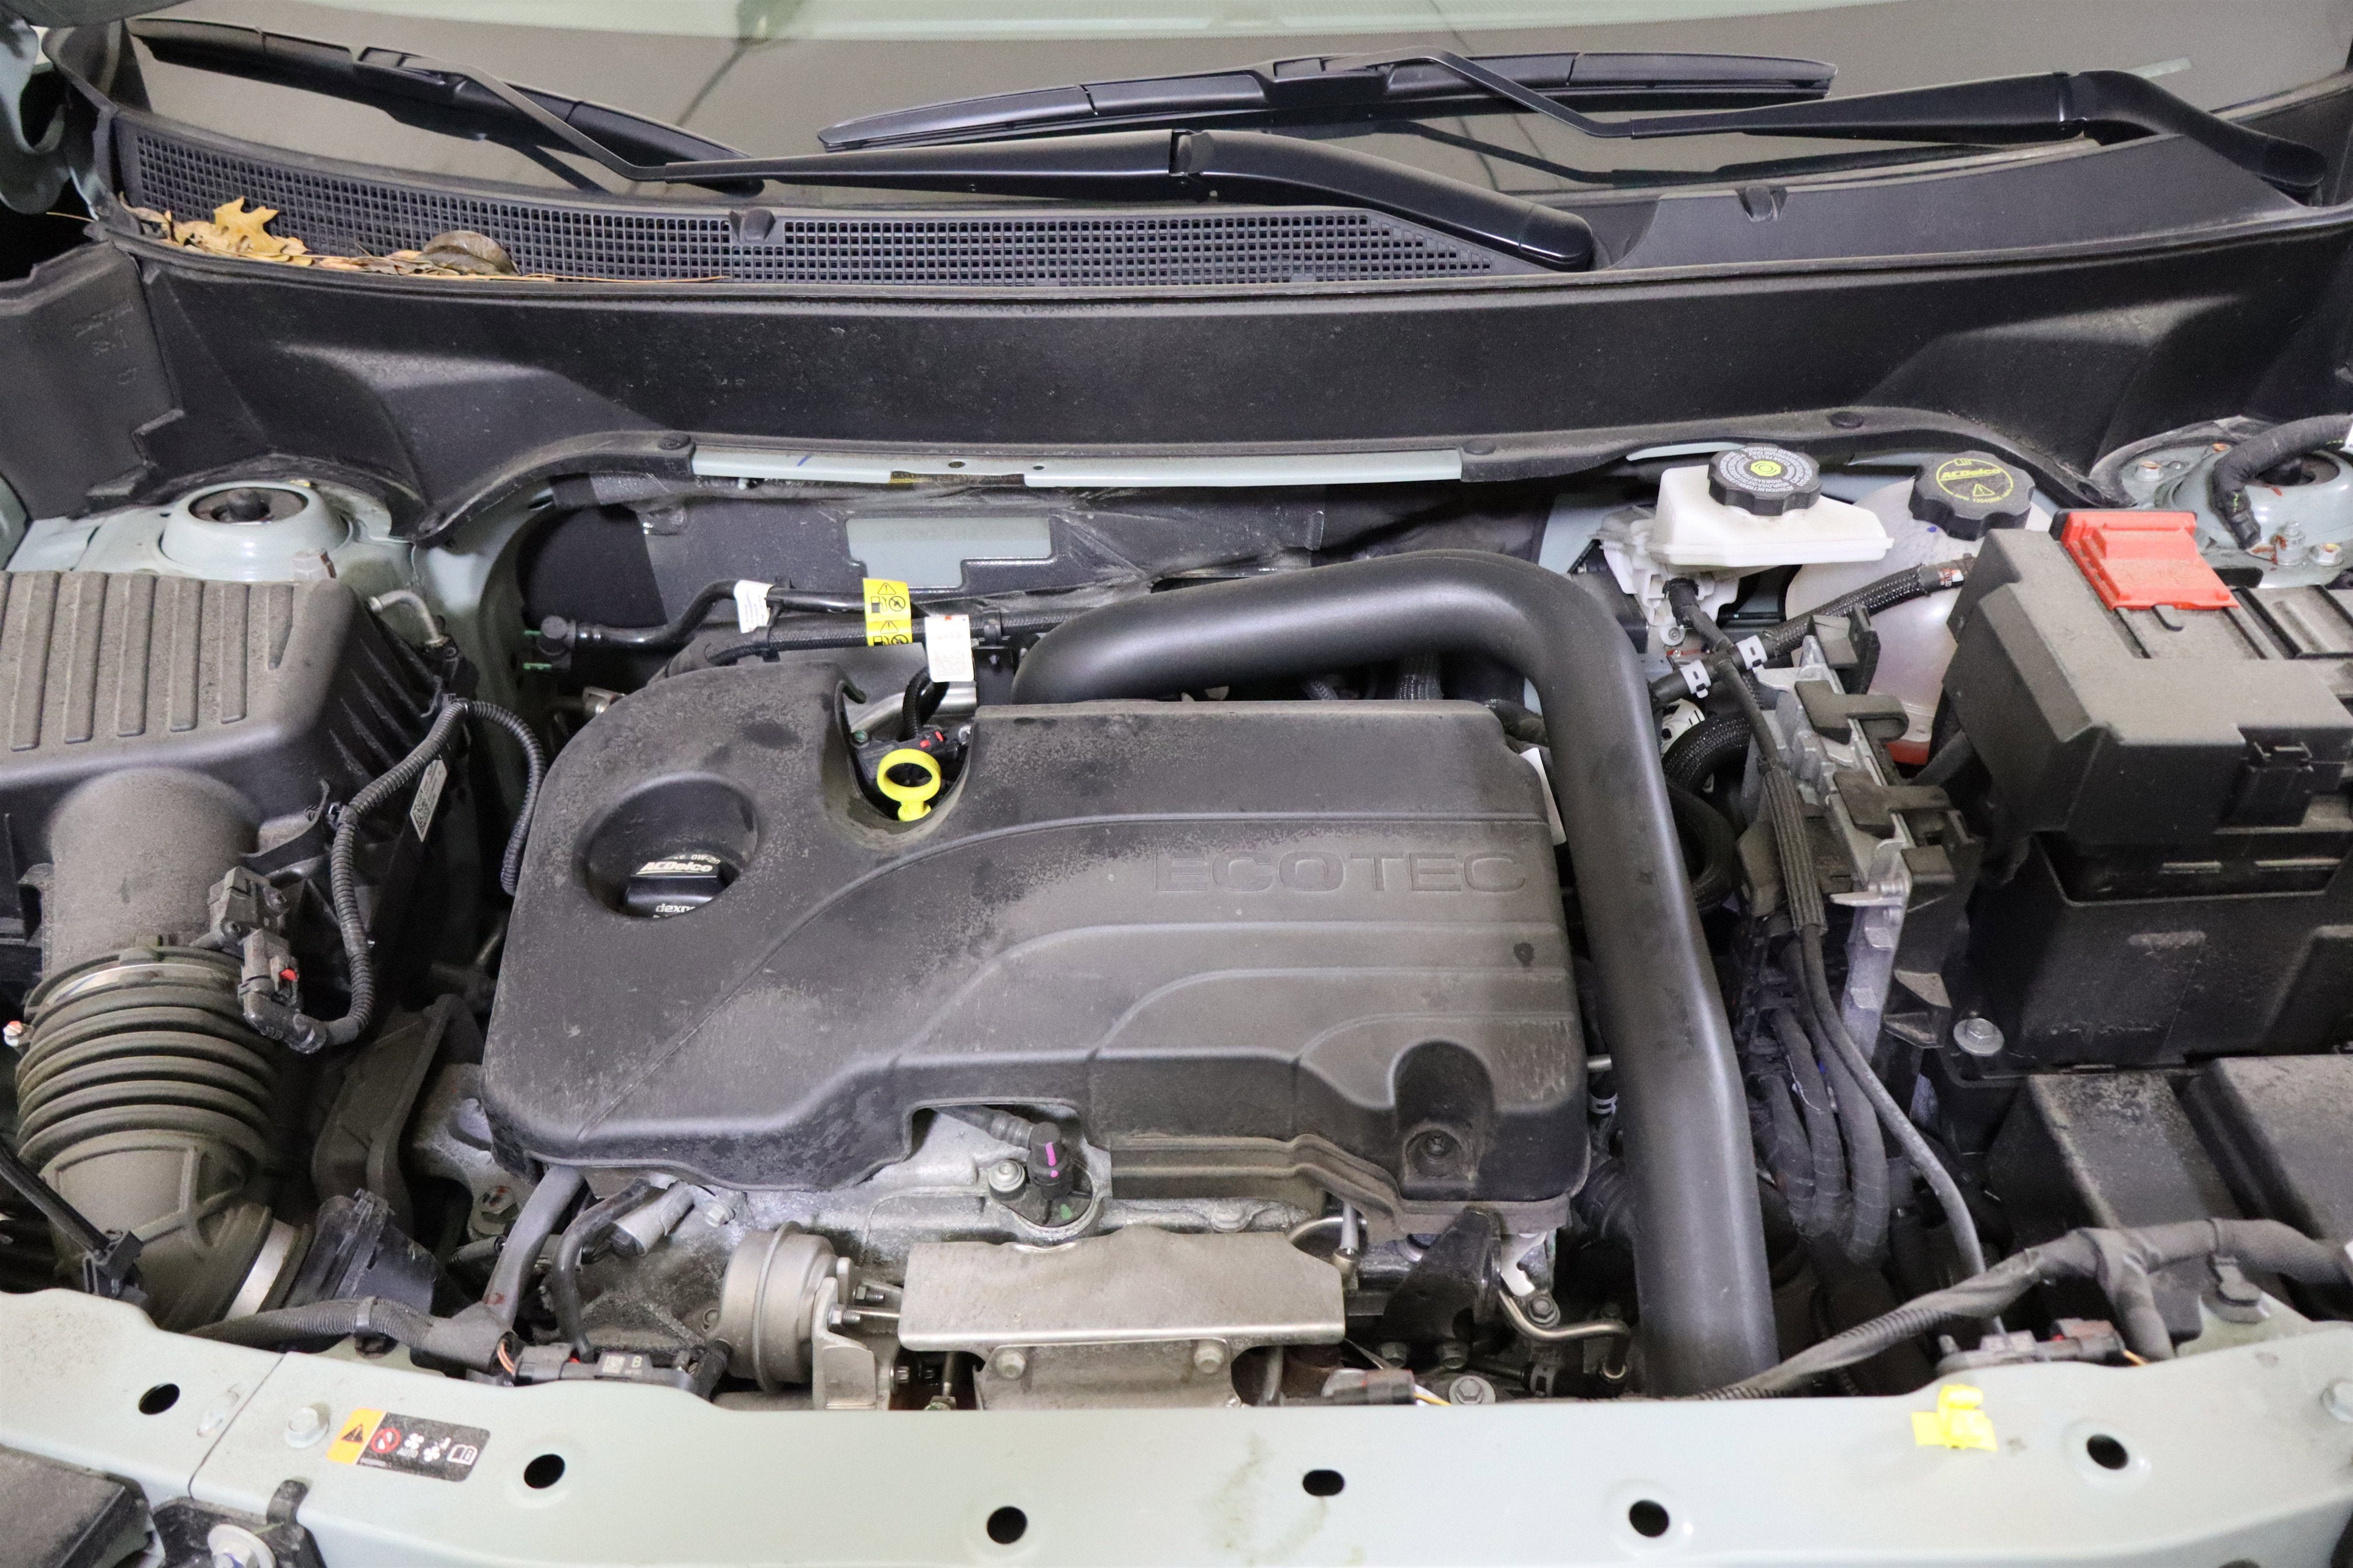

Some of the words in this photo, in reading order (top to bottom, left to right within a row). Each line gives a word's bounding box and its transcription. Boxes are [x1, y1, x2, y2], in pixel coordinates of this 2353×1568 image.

[1941, 468, 2001, 479] ACDelco
[691, 853, 721, 865] 0W-20
[639, 862, 713, 872] ACDelco
[1154, 851, 1526, 891] ECOTEC
[631, 1355, 643, 1368] B
[396, 1447, 419, 1459] AUTO
